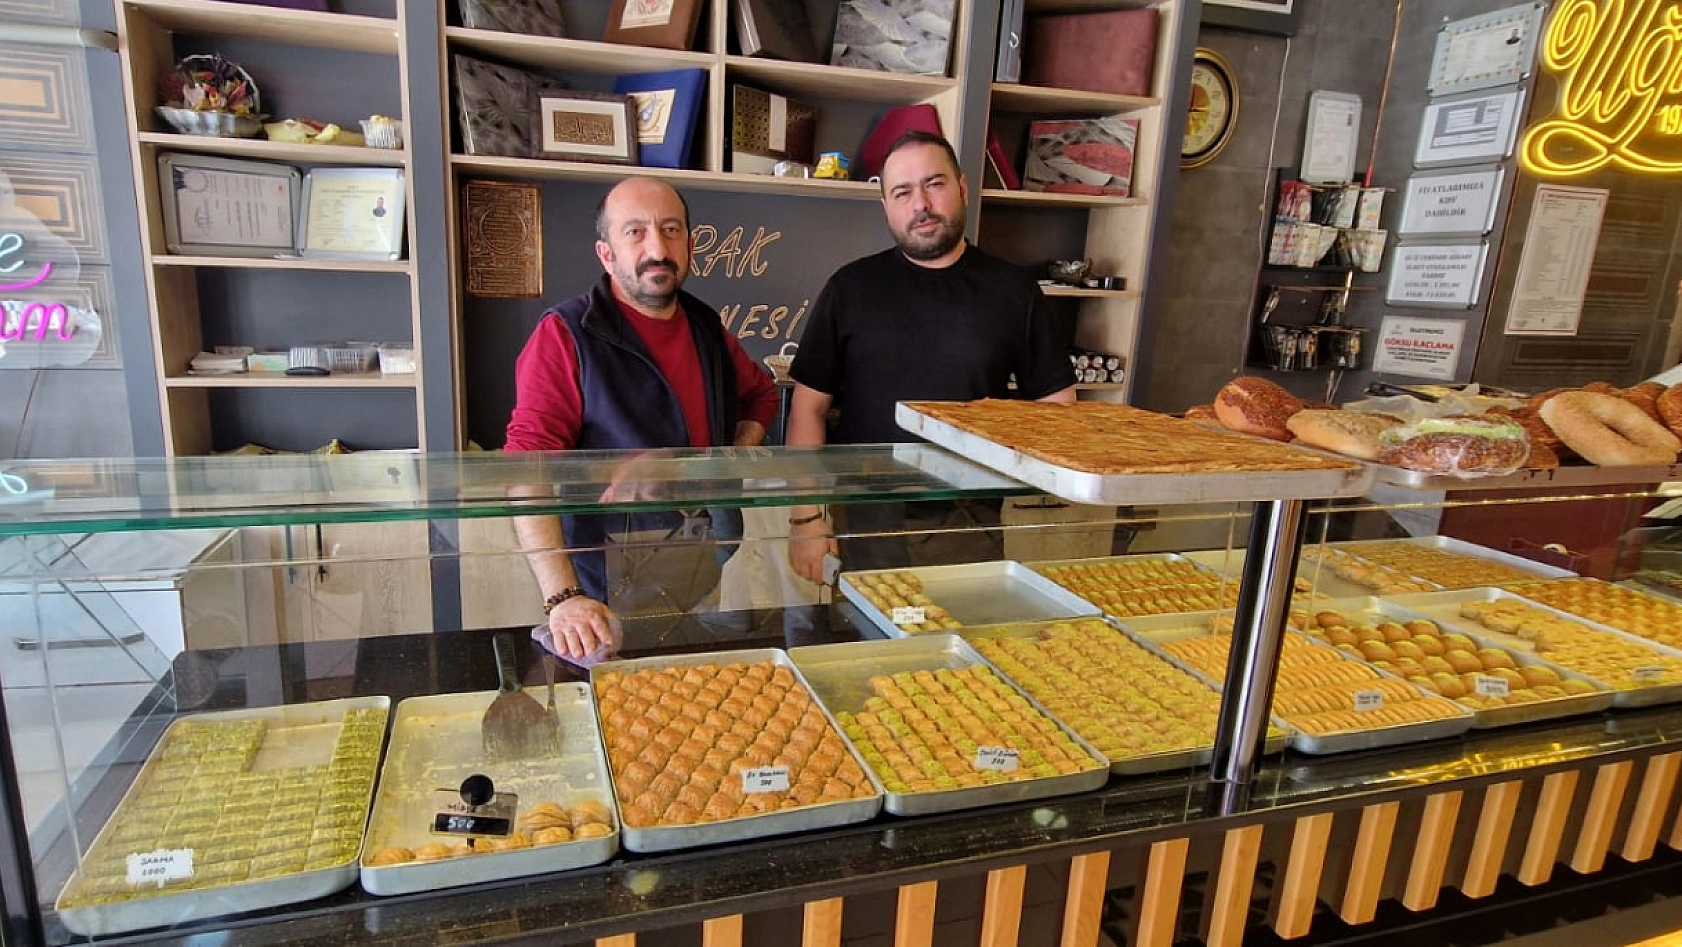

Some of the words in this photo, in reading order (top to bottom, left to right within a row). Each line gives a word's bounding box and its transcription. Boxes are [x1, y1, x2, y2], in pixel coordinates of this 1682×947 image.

[1522, 0, 1682, 175] Uğ
[1655, 105, 1682, 134] 19
[448, 816, 476, 829] 500
